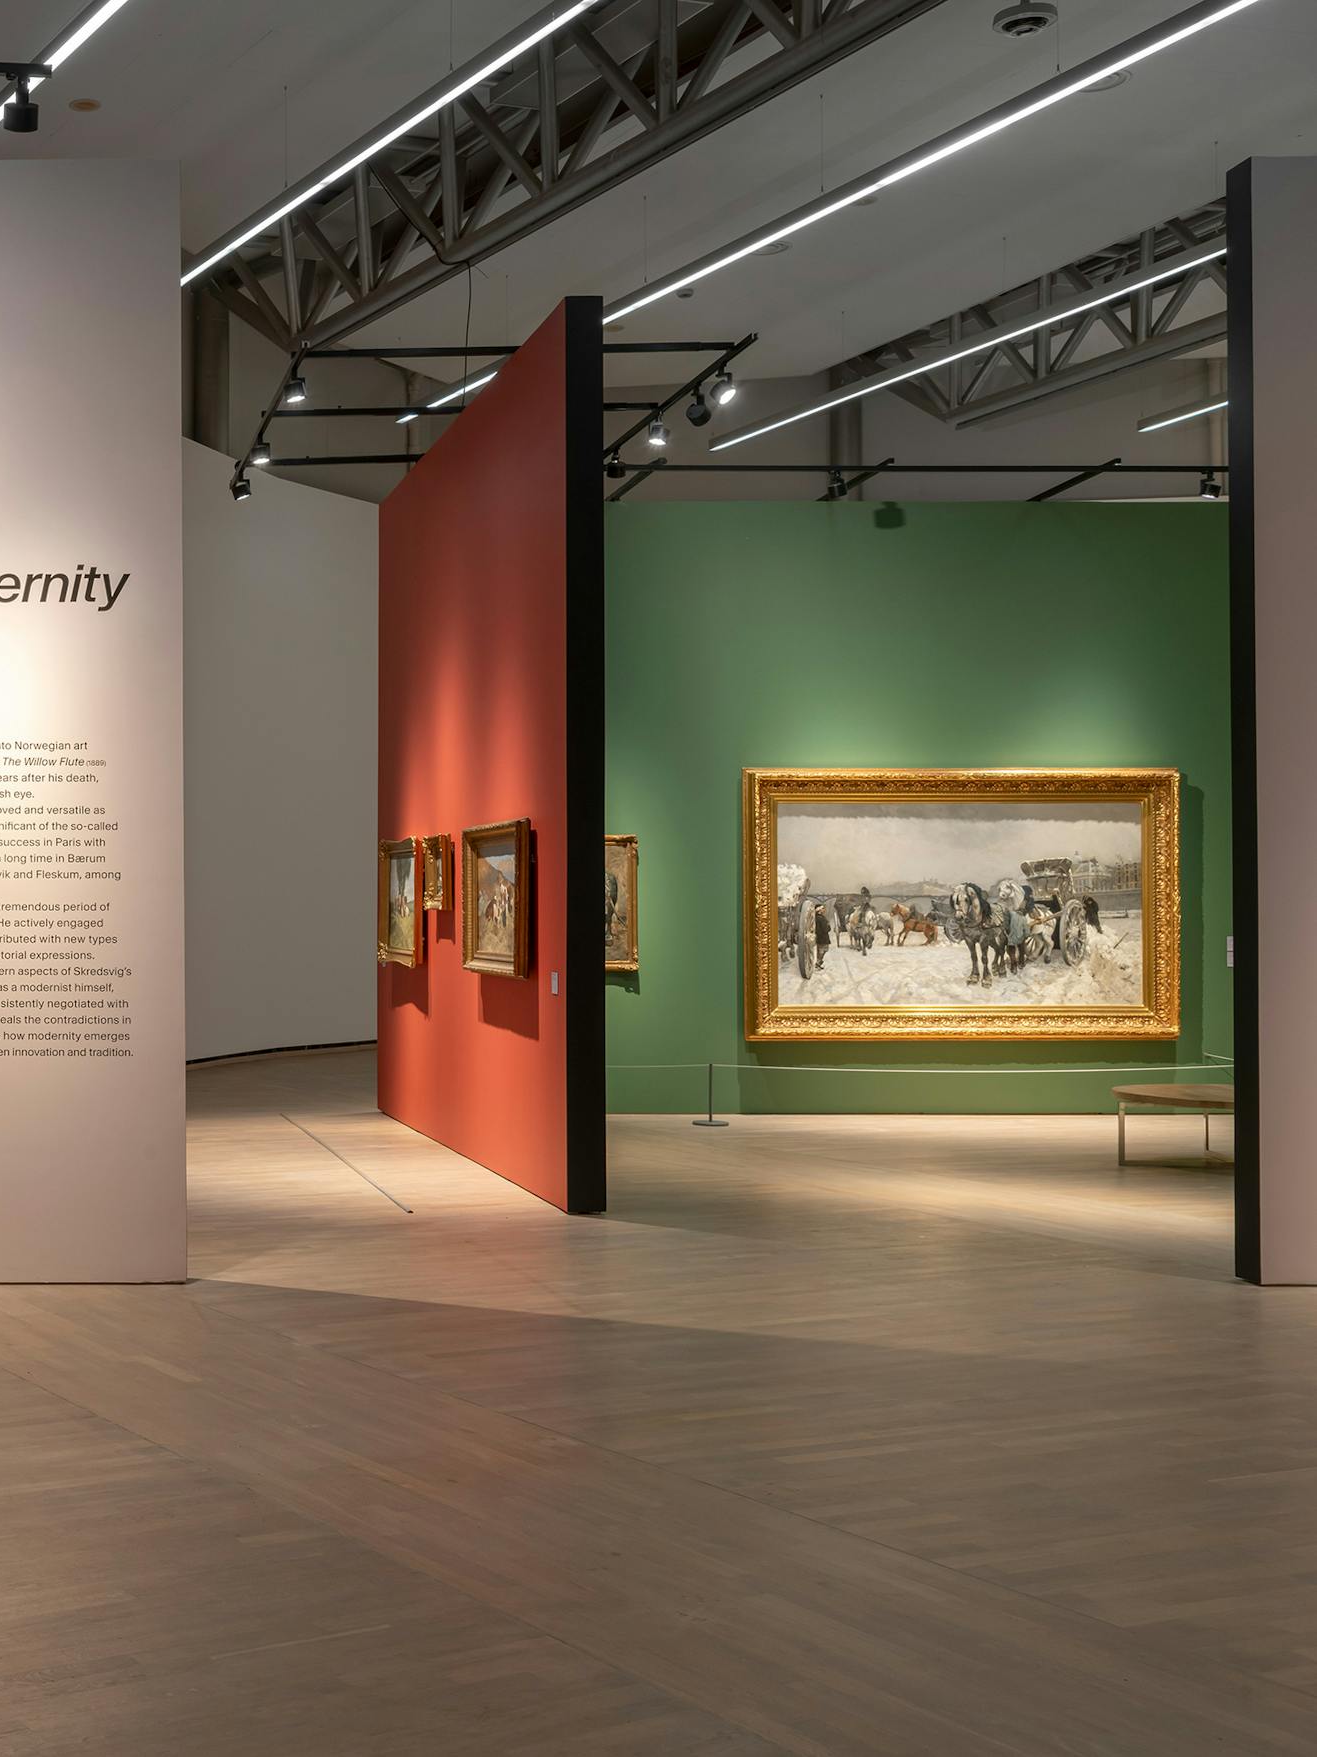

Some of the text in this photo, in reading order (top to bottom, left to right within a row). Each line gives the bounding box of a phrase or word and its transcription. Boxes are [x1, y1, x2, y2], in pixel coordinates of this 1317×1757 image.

[14, 742, 71, 752] Norwegian
[73, 742, 88, 750] art
[13, 791, 35, 800] eye.
[4, 854, 27, 864] long
[29, 854, 53, 863] time
[67, 854, 106, 863] Bærum
[13, 918, 54, 929] actively
[56, 920, 104, 929] engaged
[17, 968, 58, 977] aspects
[61, 967, 71, 975] of
[24, 1016, 41, 1024] the
[43, 1016, 119, 1024] contradictions
[122, 1016, 132, 1024] in
[12, 1048, 65, 1056] innovation
[67, 1048, 86, 1056] and
[89, 1048, 134, 1056] tradition.
